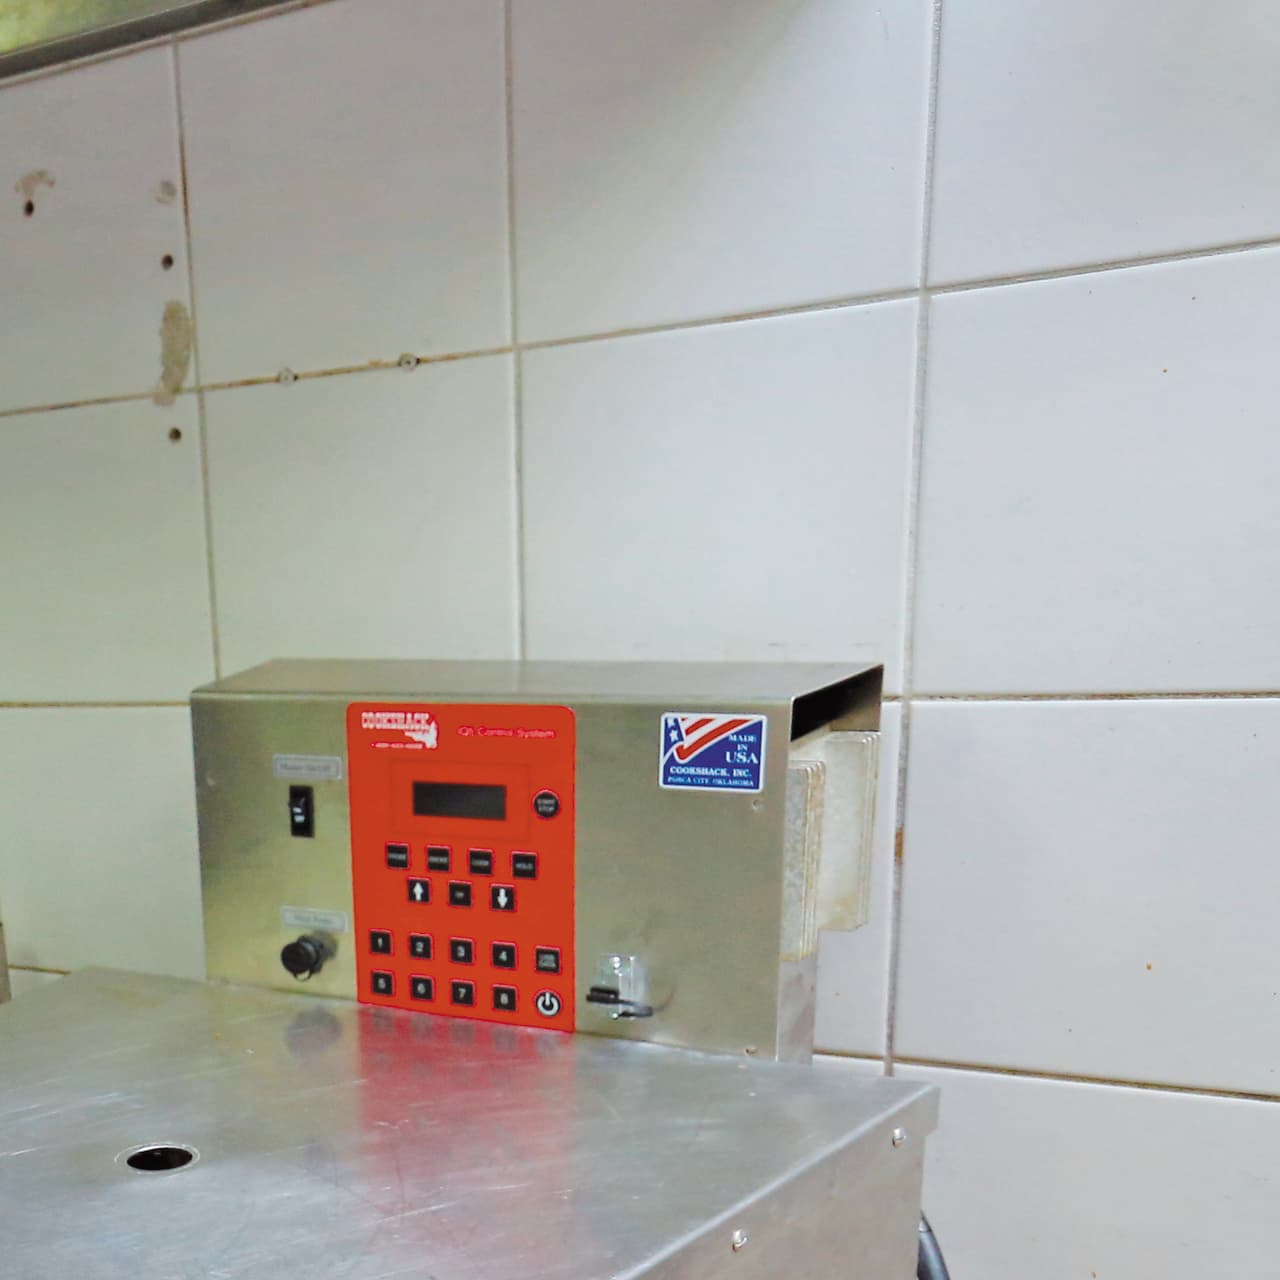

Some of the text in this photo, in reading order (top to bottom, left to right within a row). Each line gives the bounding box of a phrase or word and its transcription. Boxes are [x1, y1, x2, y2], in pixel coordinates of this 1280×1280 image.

[728, 734, 756, 742] MADE
[737, 743, 748, 751] IN
[725, 751, 759, 764] USA
[733, 768, 752, 777] INC.
